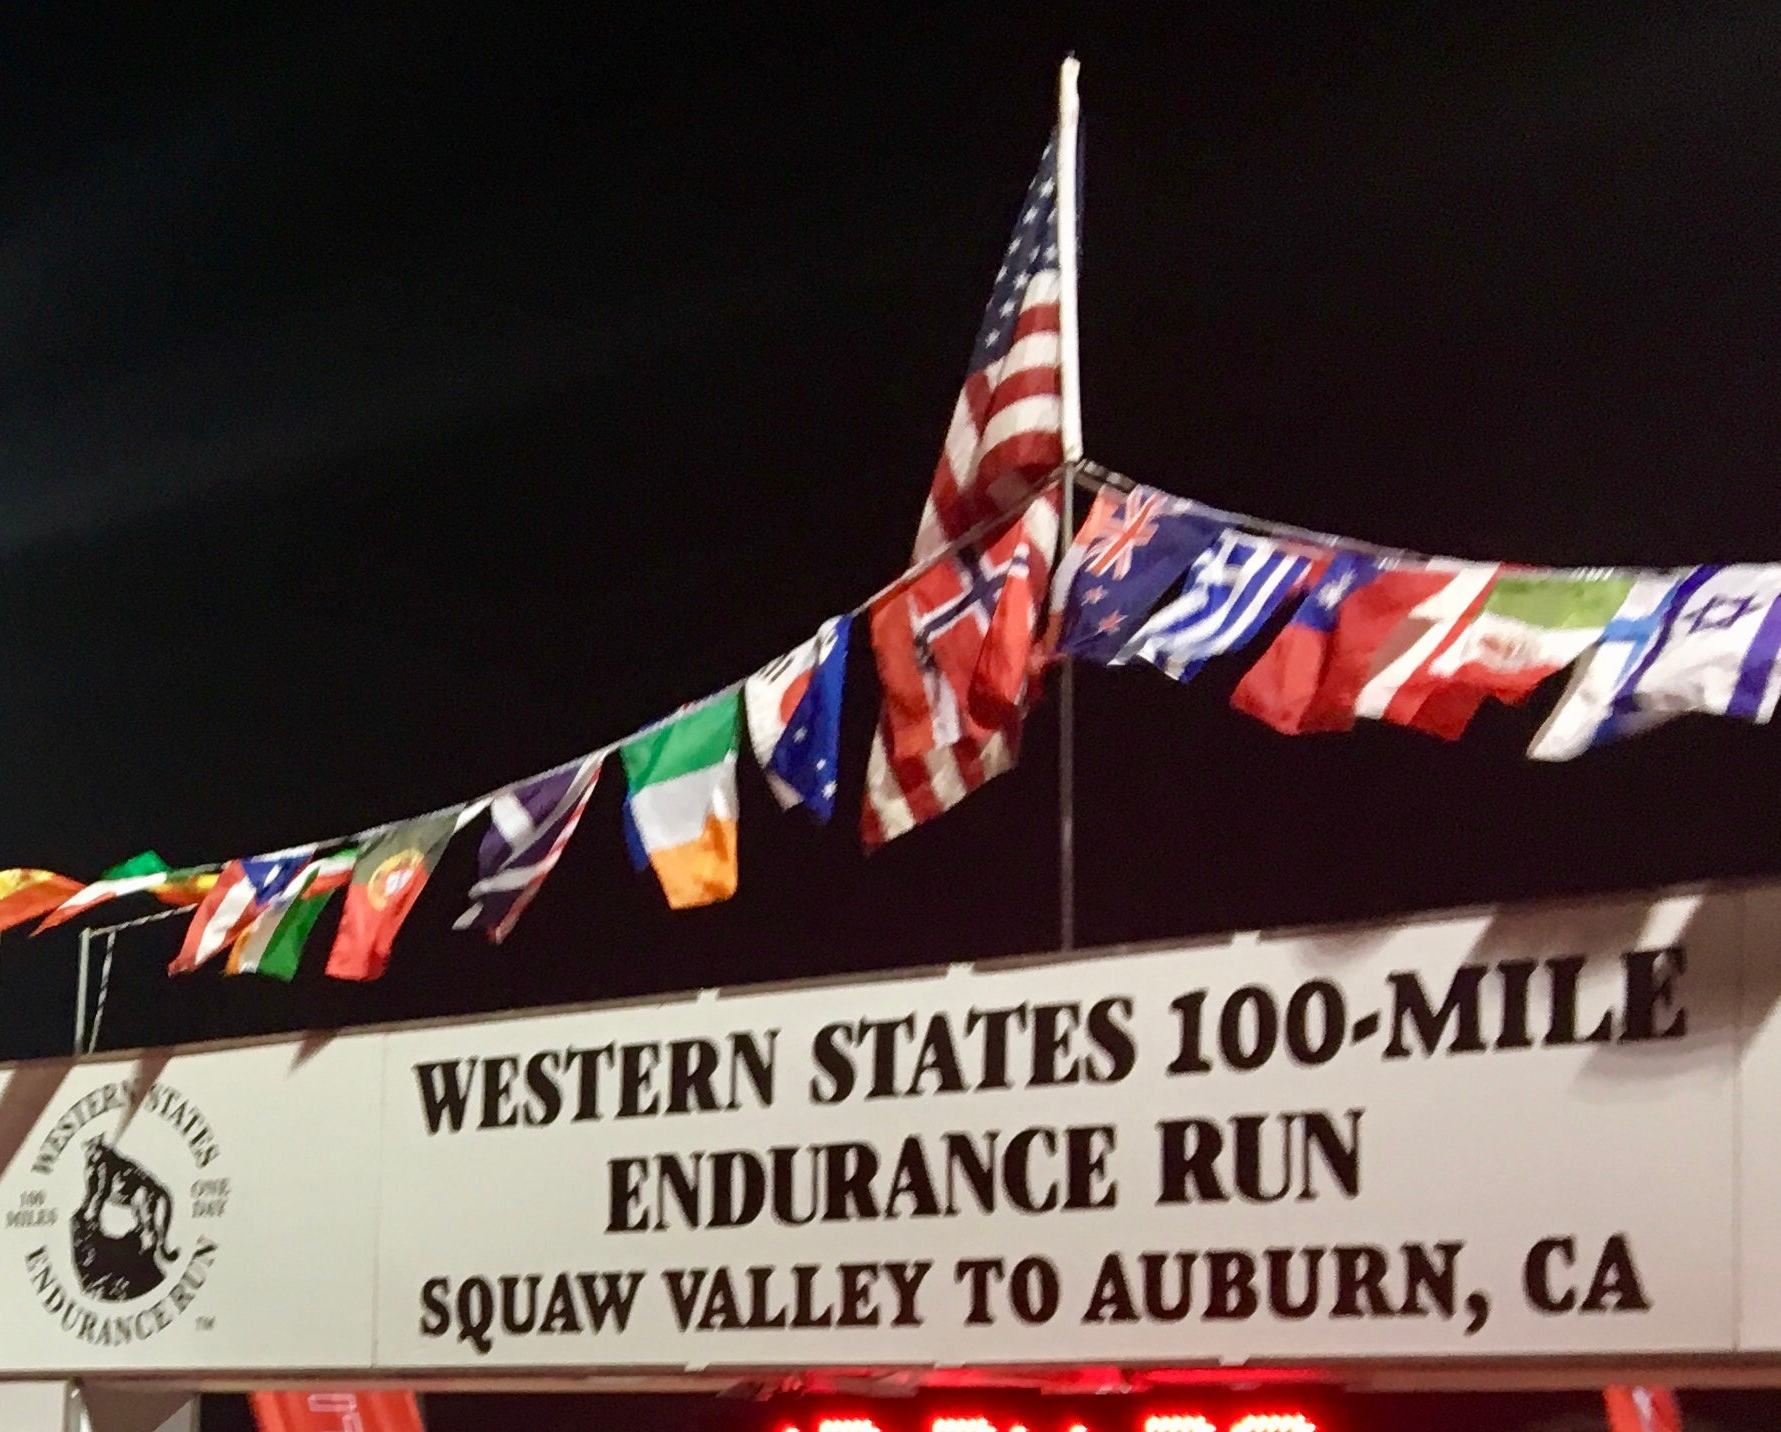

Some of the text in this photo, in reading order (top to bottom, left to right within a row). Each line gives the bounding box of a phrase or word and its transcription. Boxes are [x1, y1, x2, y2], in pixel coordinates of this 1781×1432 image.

[413, 945, 1688, 1135] WESTERN STATES 100-MILE
[30, 1079, 221, 1176] WESTERN STATES
[604, 1107, 1365, 1234] ENDURANCE RUN
[25, 1236, 219, 1347] ENDURANCE RUN
[418, 1232, 1654, 1355] SQUAW VALLEY TO AUBURN, CA
